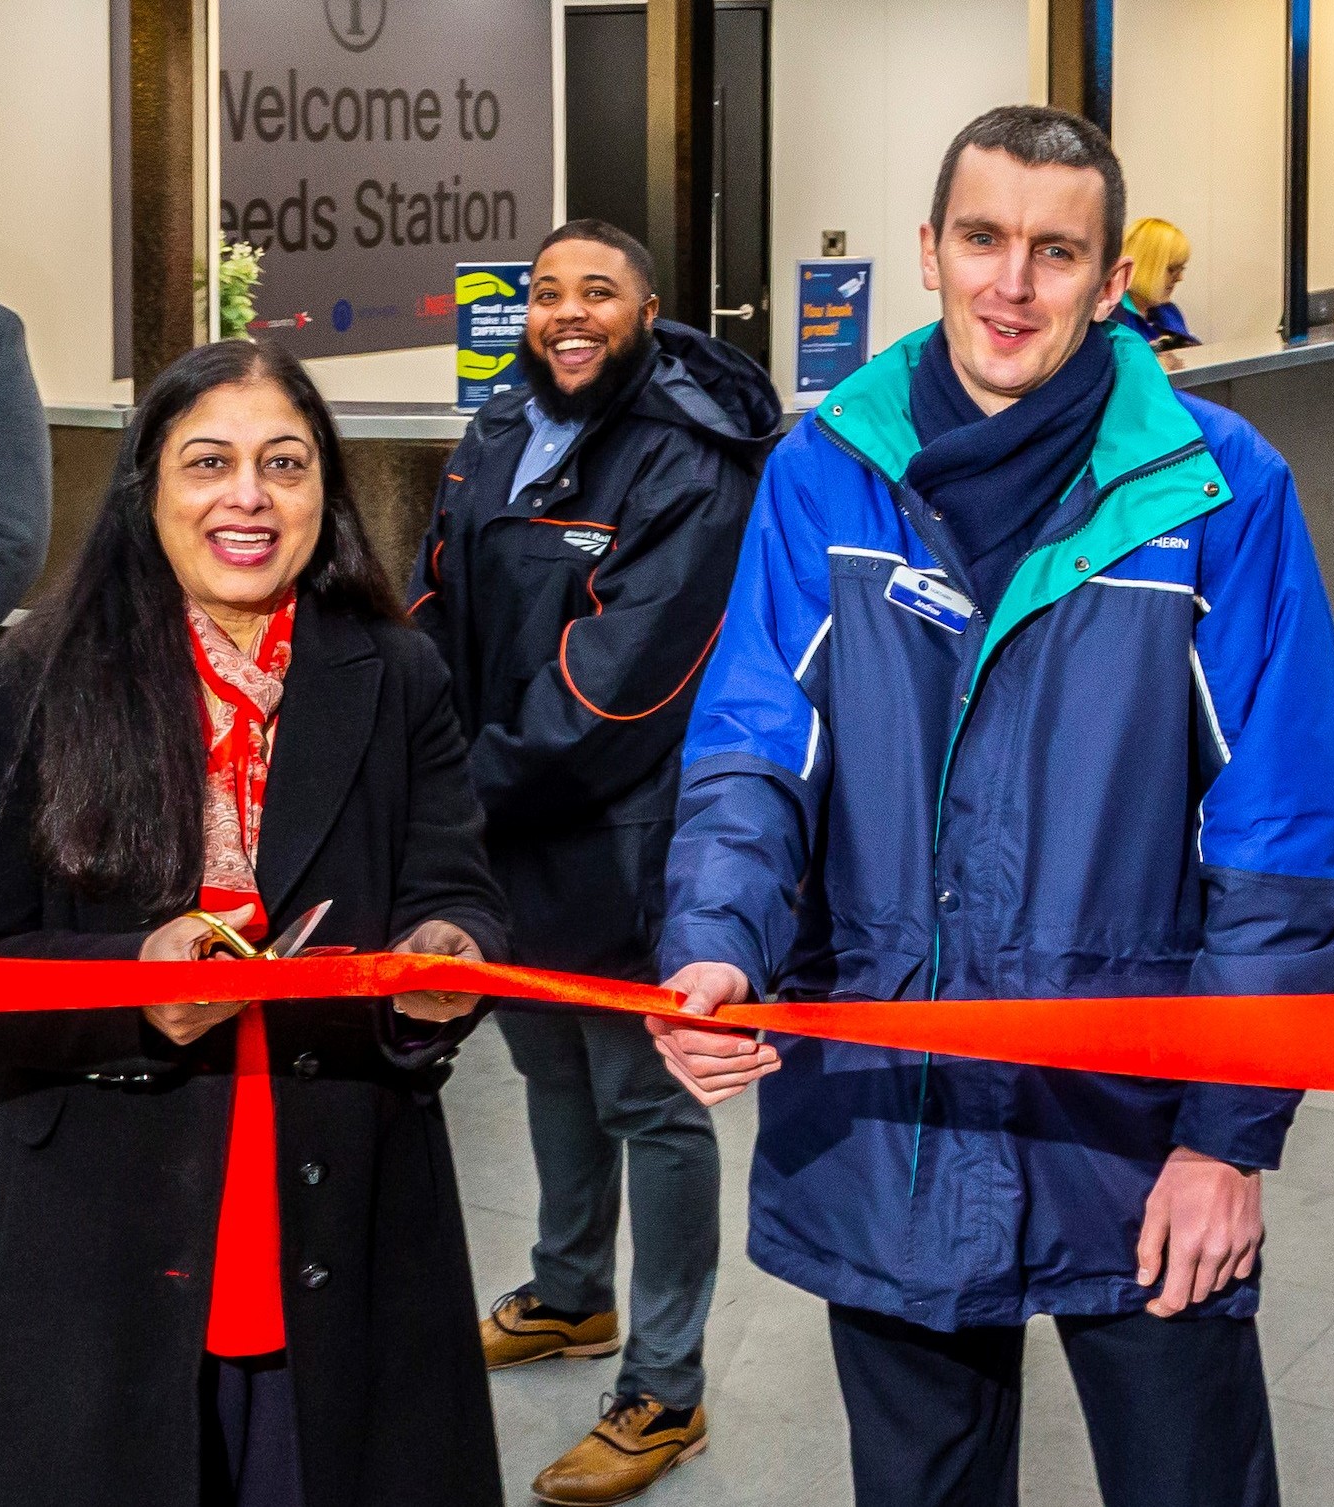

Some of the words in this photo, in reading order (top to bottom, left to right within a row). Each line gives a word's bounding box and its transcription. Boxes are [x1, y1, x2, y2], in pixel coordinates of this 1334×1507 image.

[456, 78, 500, 141] to
[220, 178, 338, 252] eeds
[353, 174, 517, 249] Station
[471, 304, 502, 314] Small
[471, 315, 500, 325] make
[500, 316, 508, 325] a
[1147, 536, 1190, 550] HERN
